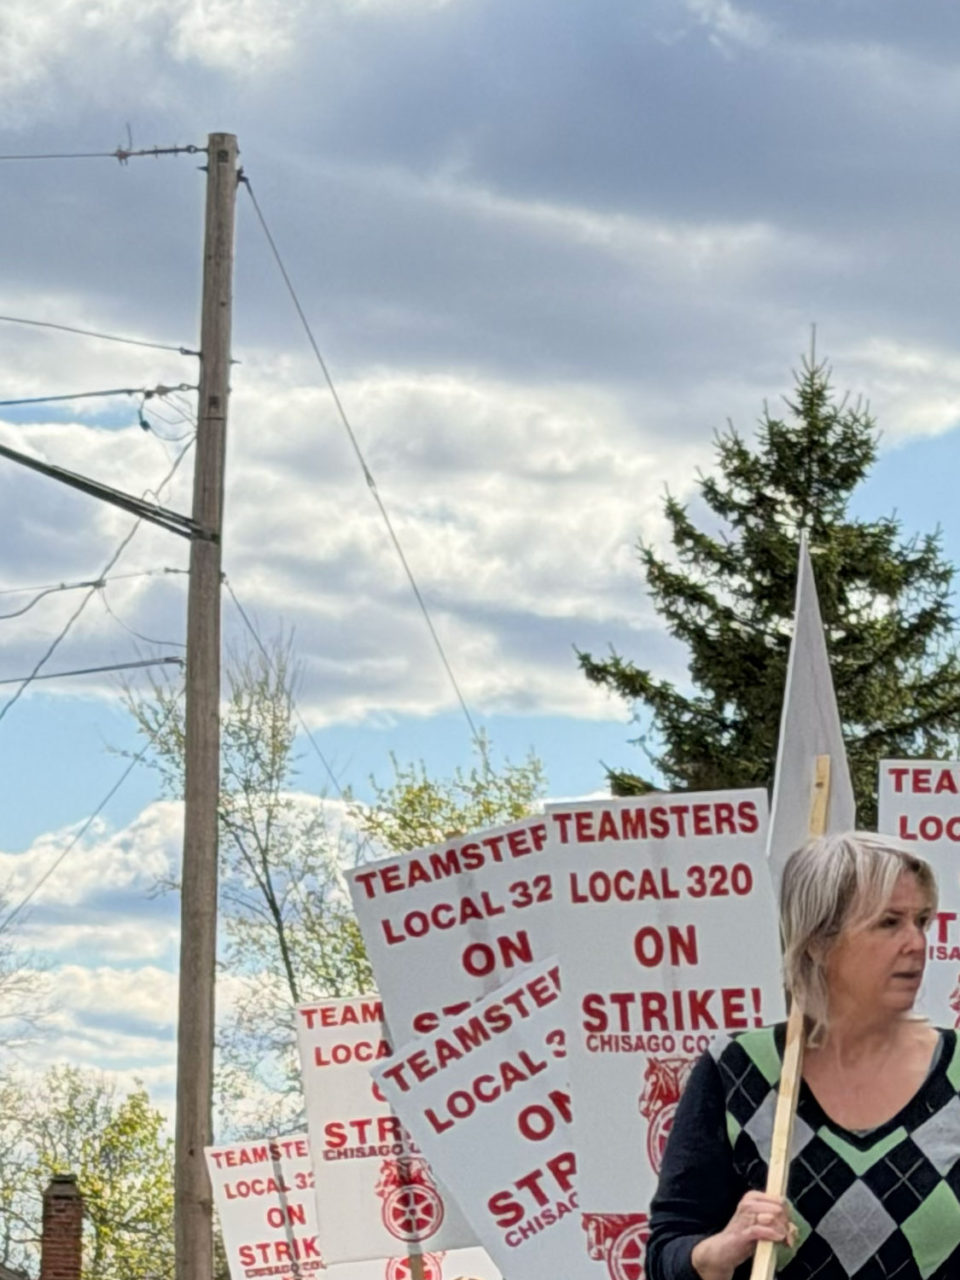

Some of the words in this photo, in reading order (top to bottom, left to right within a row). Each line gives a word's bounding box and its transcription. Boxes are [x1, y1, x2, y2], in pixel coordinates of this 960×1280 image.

[552, 801, 759, 844] TEAMSTERS
[570, 868, 680, 903] LOCAL
[686, 864, 753, 898] 320
[381, 891, 505, 945] LOCAL
[509, 875, 552, 908] 32
[462, 930, 533, 977] ON
[634, 925, 699, 968] ON
[300, 1002, 384, 1029] TEAM
[582, 988, 764, 1032] STRIKE!
[315, 1040, 393, 1067] LOCA
[586, 1034, 676, 1053] CHISAGO
[682, 1035, 716, 1054] CO
[424, 1051, 547, 1134] LOCAL
[323, 1143, 403, 1161] CHISAGO
[224, 1178, 291, 1199] LOCAL
[267, 1204, 306, 1228] ON
[238, 1236, 320, 1266] STRIK
